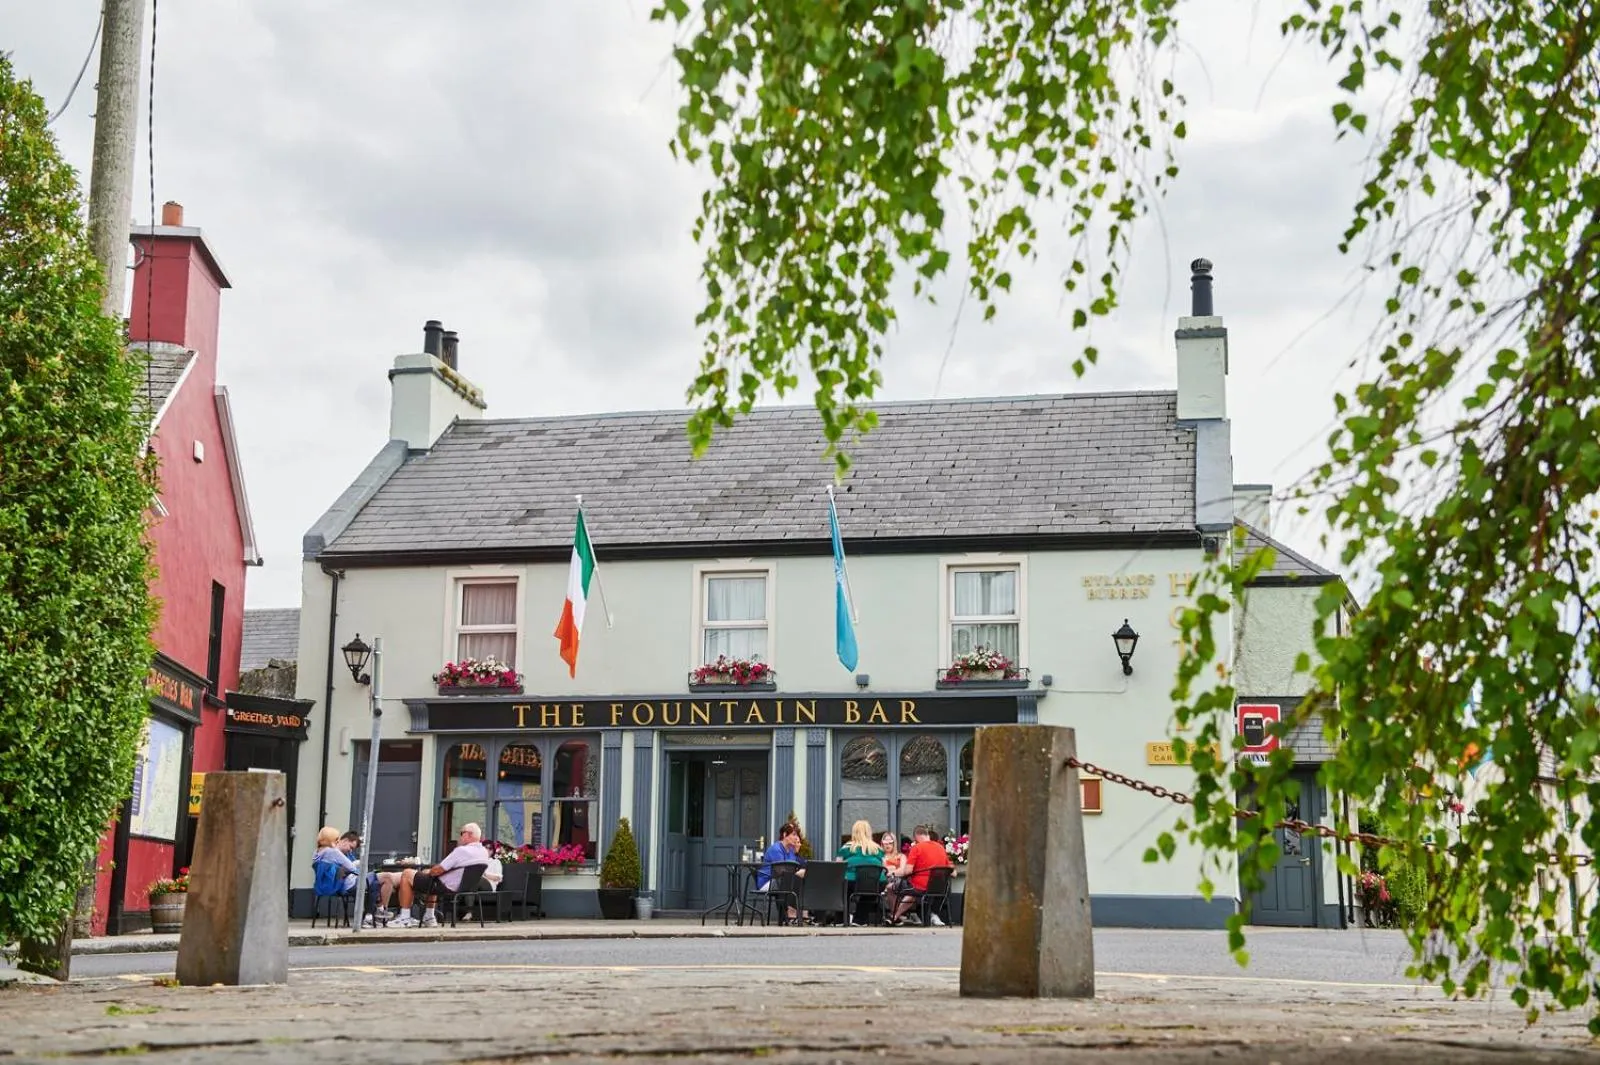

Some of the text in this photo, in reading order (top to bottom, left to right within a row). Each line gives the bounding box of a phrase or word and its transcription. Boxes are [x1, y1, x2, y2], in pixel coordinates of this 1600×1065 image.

[1088, 587, 1149, 600] BURREN
[512, 700, 922, 728] THE FOUNTAIN BAR
